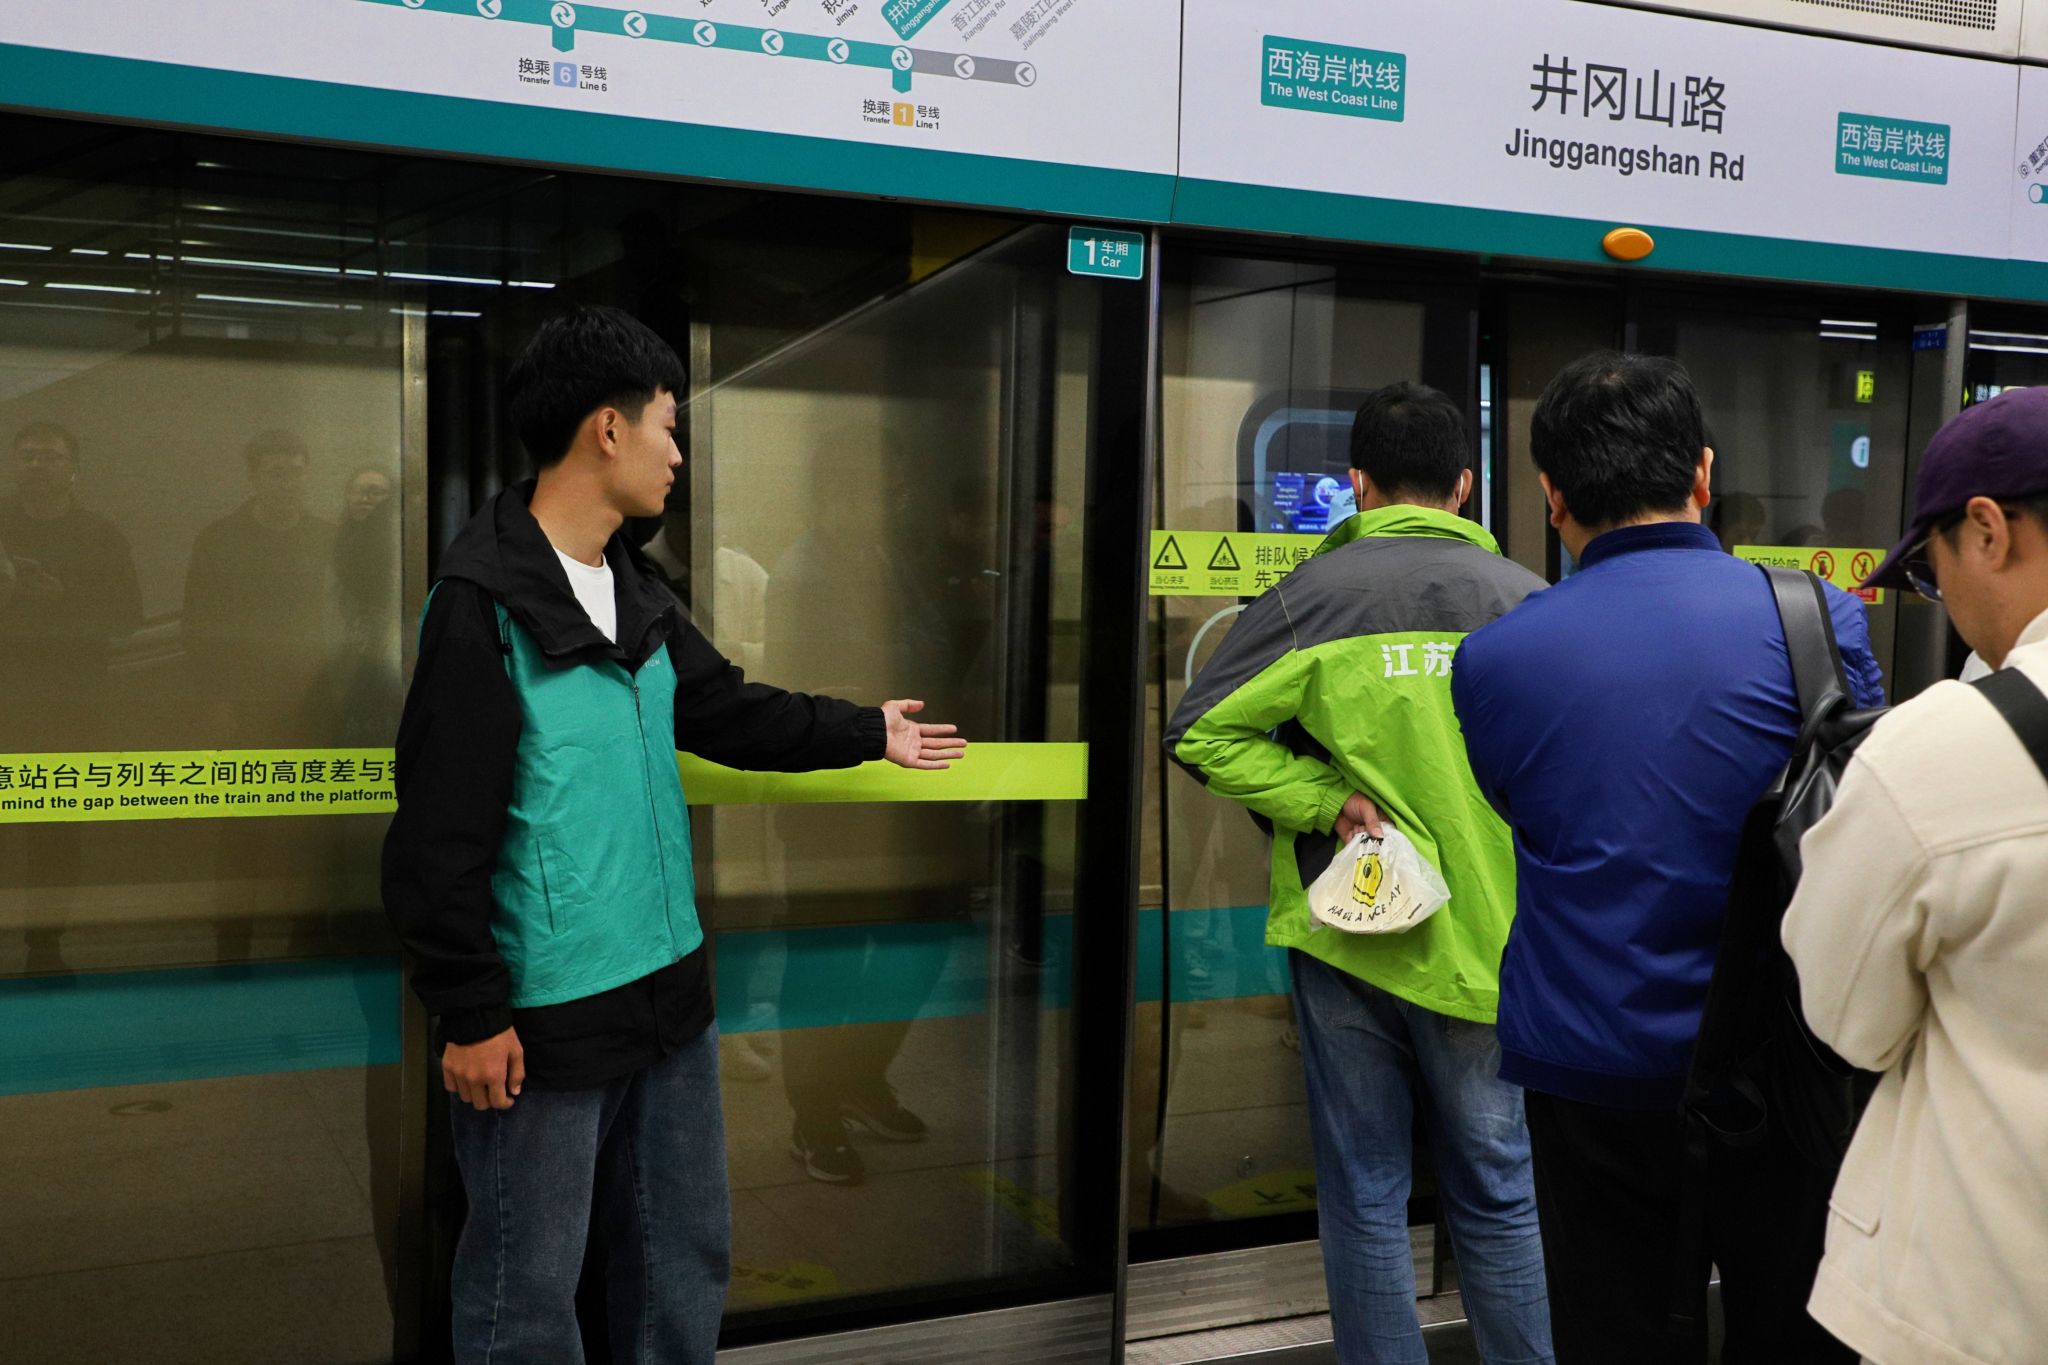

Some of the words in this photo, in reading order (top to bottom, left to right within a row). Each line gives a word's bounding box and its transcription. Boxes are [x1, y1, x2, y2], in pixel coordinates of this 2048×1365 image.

[836, 3, 858, 27] Jimiya
[888, 0, 921, 25] 井冈
[900, 0, 940, 35] Jinggangsh
[962, 9, 997, 42] Xiangjiang
[518, 57, 551, 76] 换乘
[560, 66, 572, 83] 6
[580, 64, 607, 81] 号线
[518, 74, 551, 85] Transfer
[580, 81, 600, 91] Line
[601, 83, 608, 92] 6
[1268, 47, 1400, 93] 西海岸快线
[1269, 81, 1293, 97] The
[1296, 85, 1329, 102] West
[1331, 90, 1368, 106] Coast
[1371, 95, 1398, 110] Line
[1530, 53, 1727, 135] 井冈山路
[863, 99, 891, 116] 换乘
[916, 105, 940, 120] 号线
[863, 115, 891, 125] Transfer
[916, 120, 933, 129] Line
[935, 122, 940, 130] 1
[1505, 127, 1700, 176] Jinggangshan
[1709, 151, 1744, 181] Rd
[1840, 122, 1946, 160] 西海岸快线
[1841, 152, 1861, 166] The
[1863, 155, 1889, 170] West
[1890, 158, 1920, 173] Coast
[1921, 161, 1943, 175] Line
[1083, 237, 1096, 266] 1
[1100, 239, 1129, 256] 车厢
[1101, 255, 1121, 268] Car
[1255, 546, 1315, 565] 排队候
[1380, 641, 1455, 678] 江苏
[0, 758, 397, 790] 意站台与列车之间的高度差与
[1, 797, 45, 810] mind
[50, 796, 77, 809] the
[83, 797, 114, 811] gap
[119, 794, 189, 807] between
[194, 792, 219, 805] the
[225, 791, 261, 804] train
[266, 790, 295, 803] and
[300, 790, 325, 802] the
[329, 788, 397, 804] platform.
[1355, 912, 1363, 922] A
